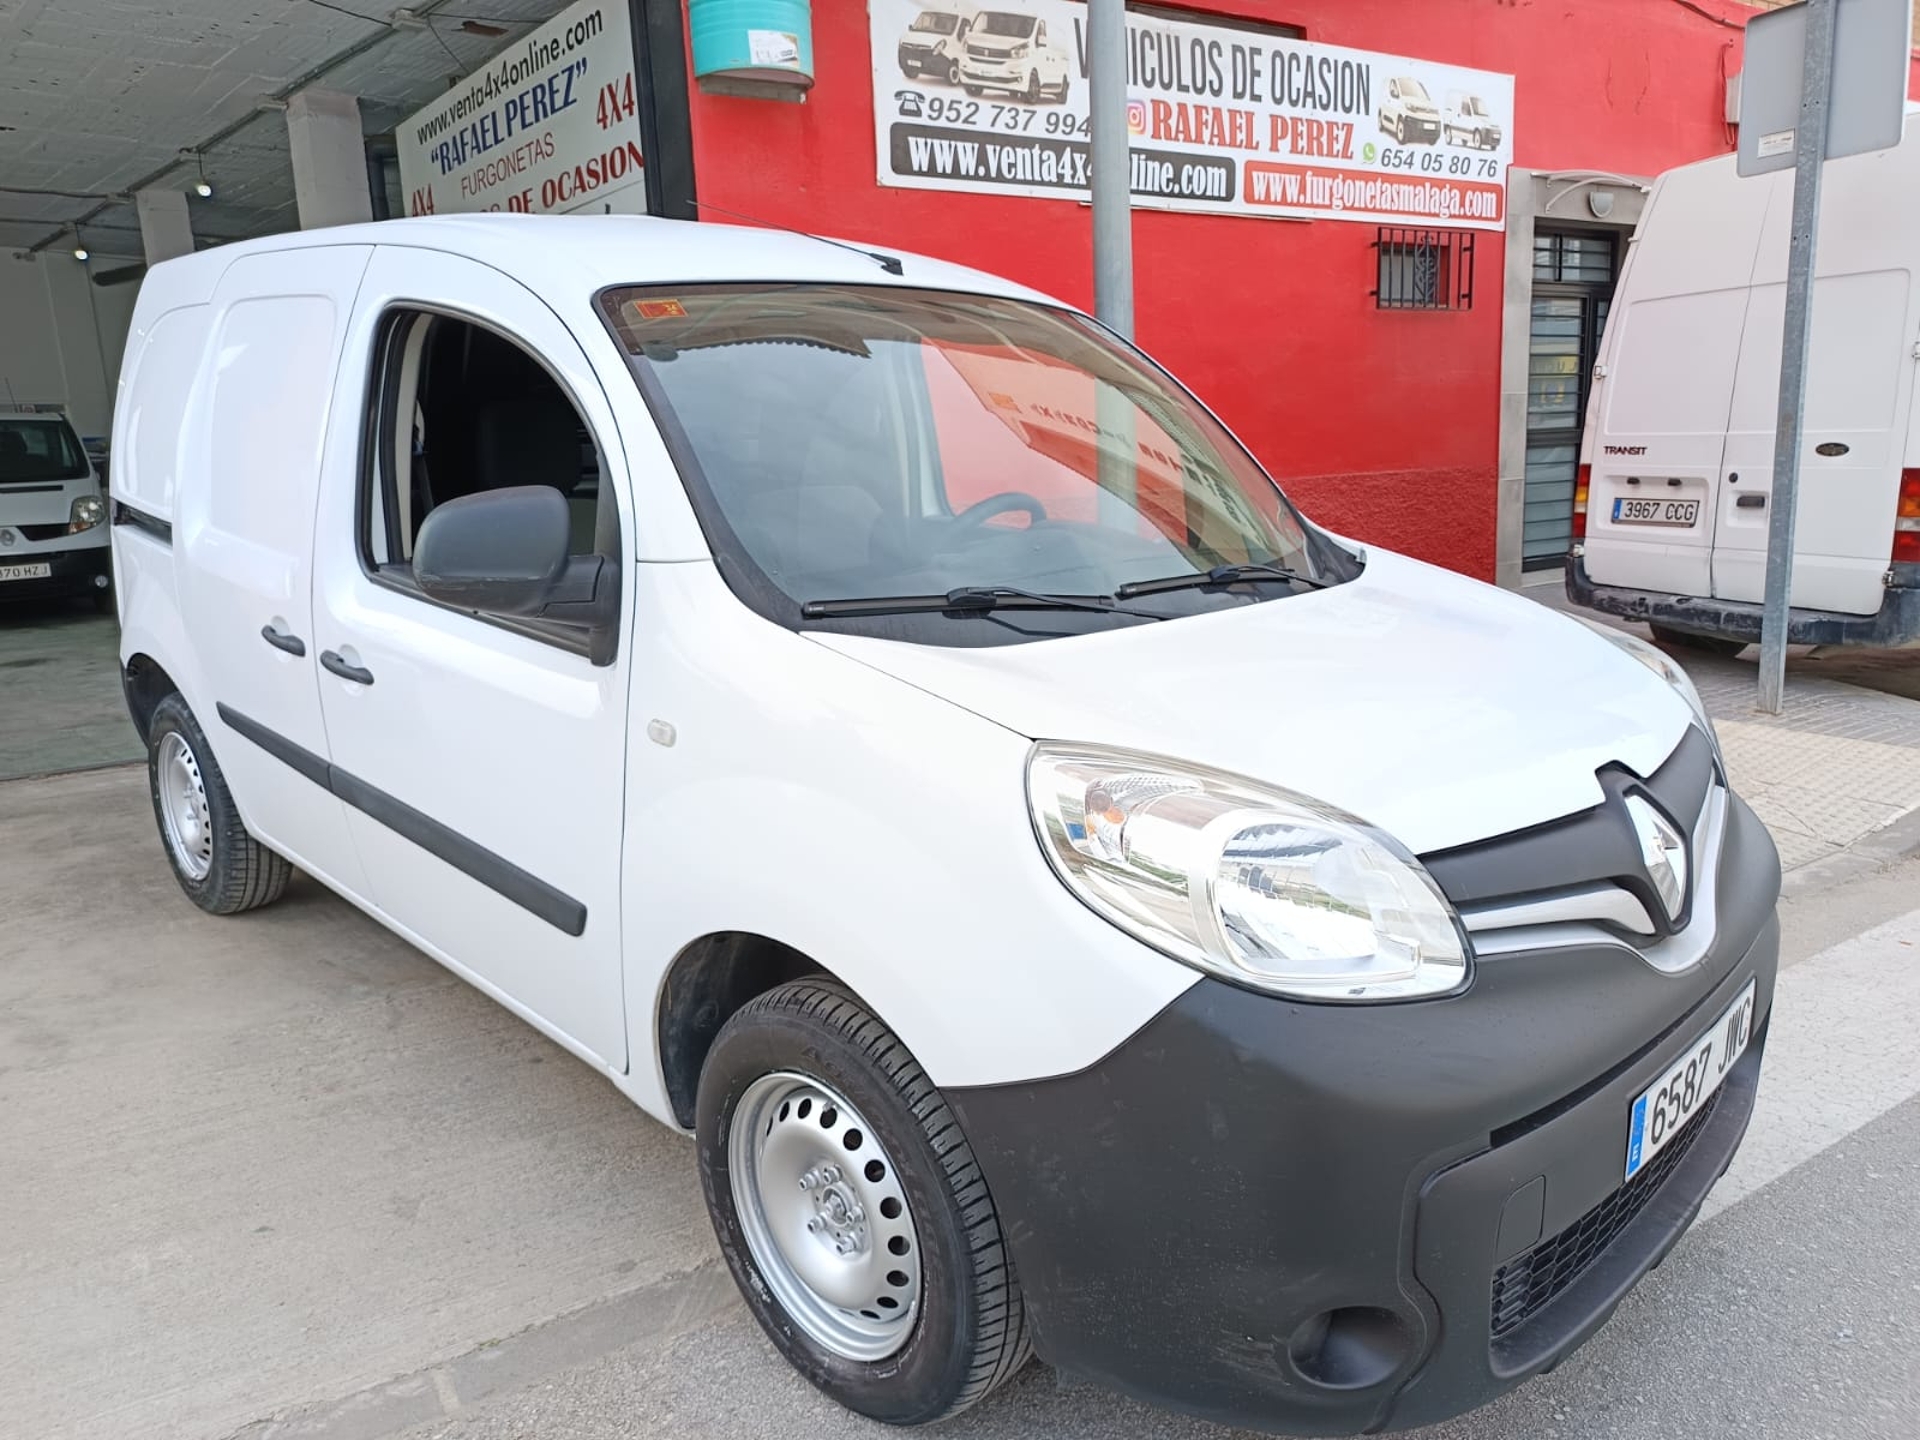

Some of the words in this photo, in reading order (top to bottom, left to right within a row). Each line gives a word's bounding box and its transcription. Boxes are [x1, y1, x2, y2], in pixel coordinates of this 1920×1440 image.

[417, 10, 602, 145] www.venta4x4online.com
[1073, 17, 1223, 97] VICULOS
[1231, 44, 1262, 103] DE
[1271, 49, 1370, 116] OCASION
[596, 72, 635, 130] 4X4
[926, 96, 980, 126] 952
[989, 104, 1038, 132] 737
[1045, 112, 1092, 138] 994
[1150, 99, 1260, 151] RAFAEL
[1268, 113, 1355, 160] PEREZ
[461, 132, 555, 198] FURGONETAS
[908, 136, 1227, 197] www.venta4xline.com
[1381, 148, 1415, 169] 654
[1421, 152, 1444, 172] 05
[1449, 155, 1471, 175] 80
[1477, 159, 1498, 178] 76
[412, 183, 435, 217] 4X4
[1252, 170, 1497, 218] www.furgonetasmalaga.com
[1603, 445, 1648, 456] TRANSIT
[1624, 502, 1661, 519] 3967
[1665, 503, 1694, 521] CCG
[1651, 1041, 1713, 1145] 6587
